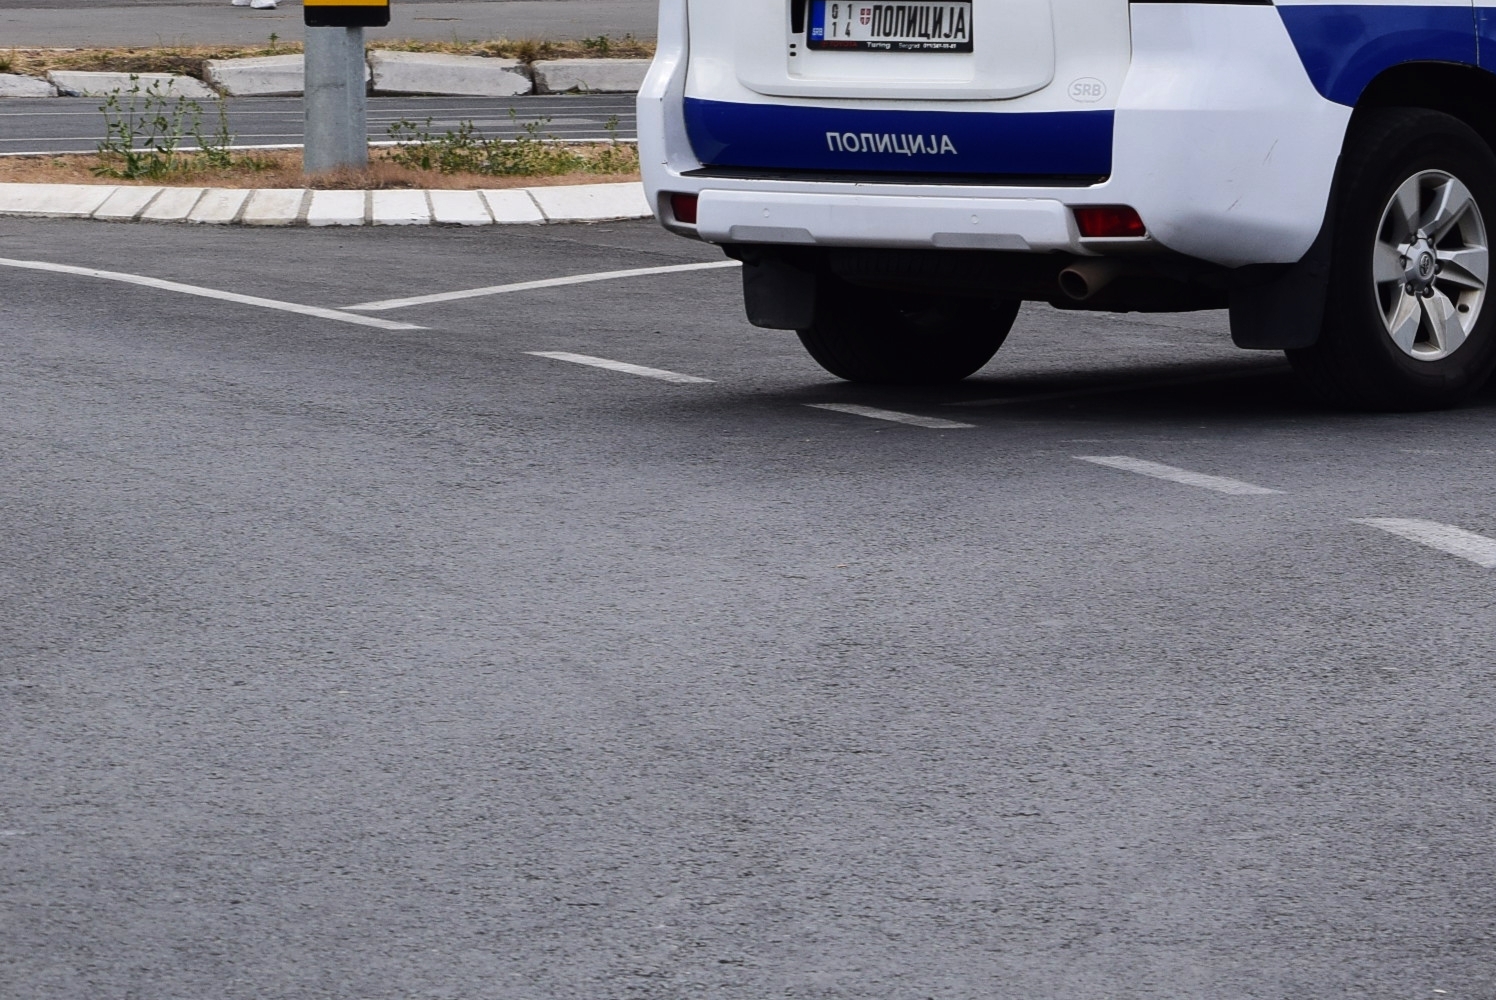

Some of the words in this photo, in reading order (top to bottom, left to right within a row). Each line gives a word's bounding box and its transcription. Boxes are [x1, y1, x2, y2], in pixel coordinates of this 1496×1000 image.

[871, 5, 966, 40] ПОЛИЦИЈА
[1073, 83, 1101, 97] SRB
[825, 131, 958, 157] ПОЛИЦИЈА
